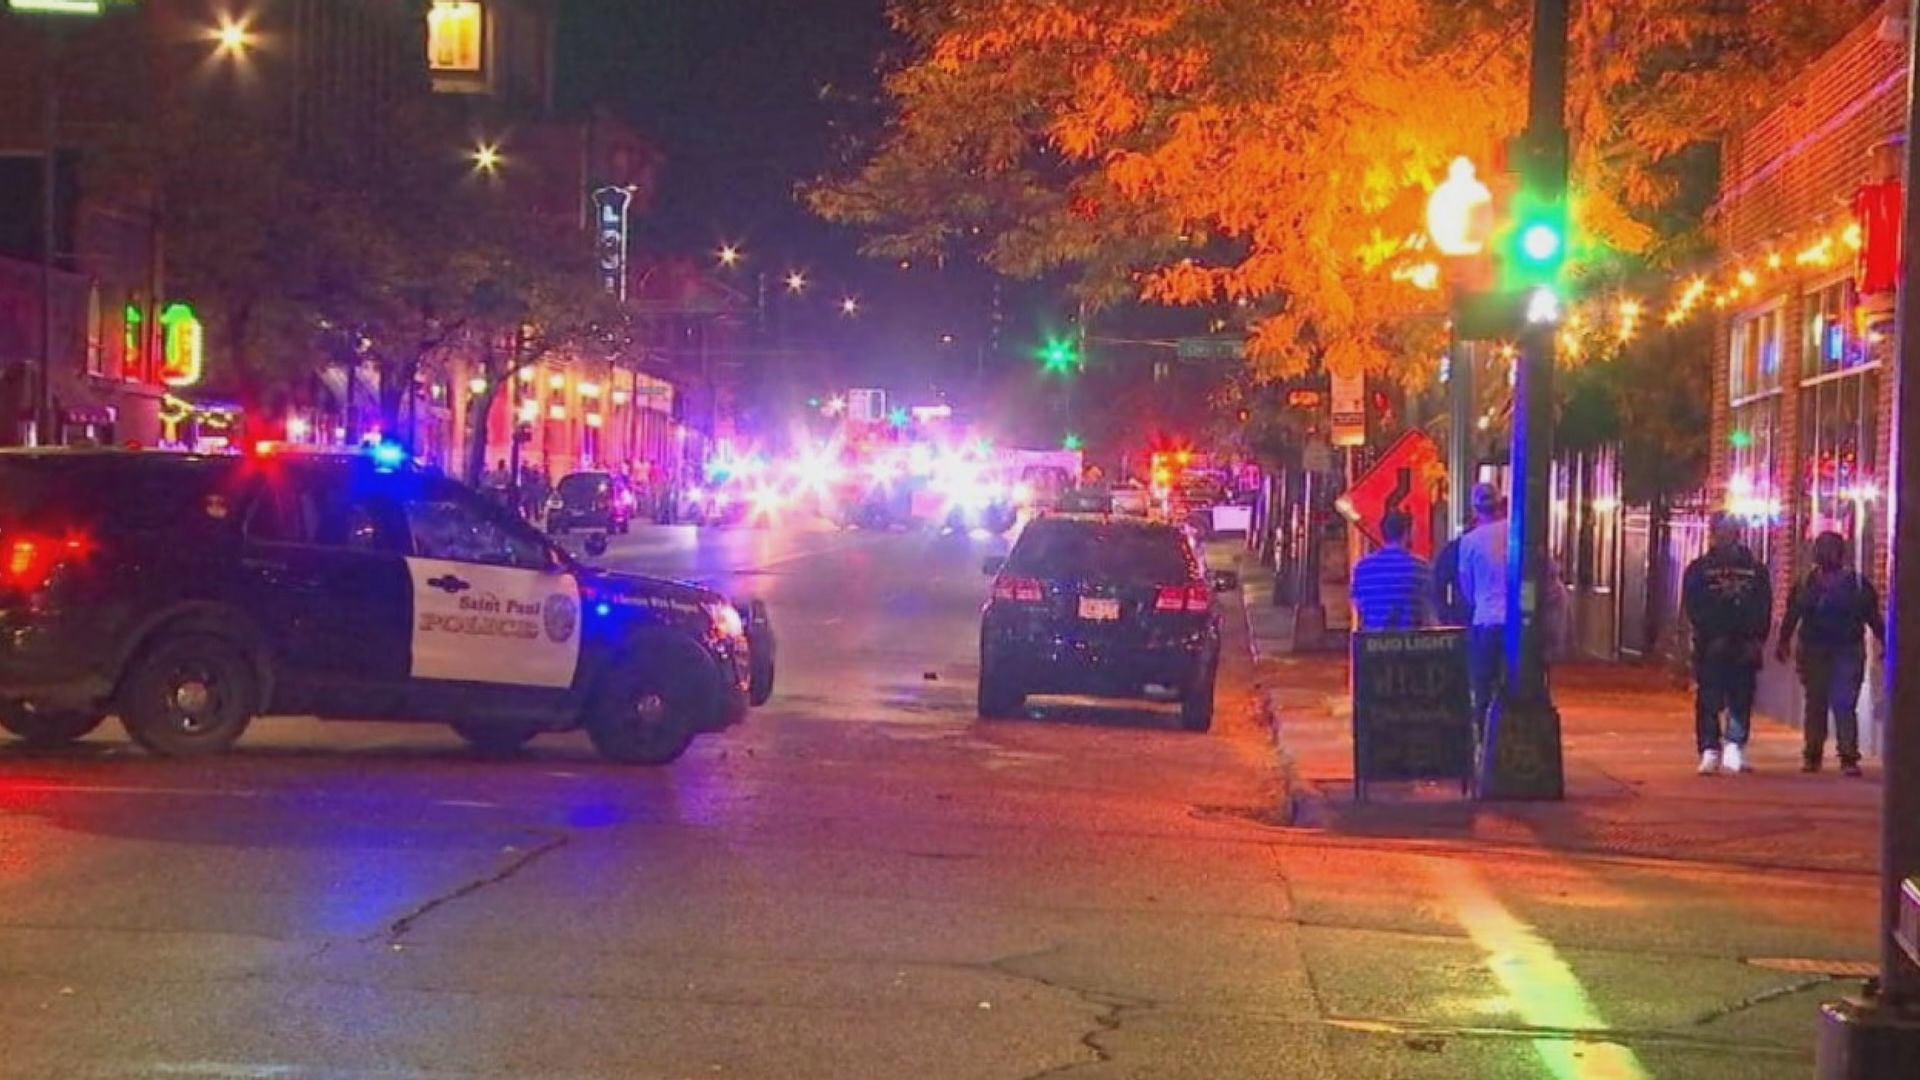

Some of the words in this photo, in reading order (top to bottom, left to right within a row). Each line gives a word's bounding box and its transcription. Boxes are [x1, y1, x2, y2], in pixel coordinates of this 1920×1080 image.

[459, 597, 500, 613] Saint
[506, 600, 541, 615] Paul
[419, 613, 539, 639] POLICE
[1366, 637, 1402, 651] BUD
[1405, 635, 1457, 650] LIGHT
